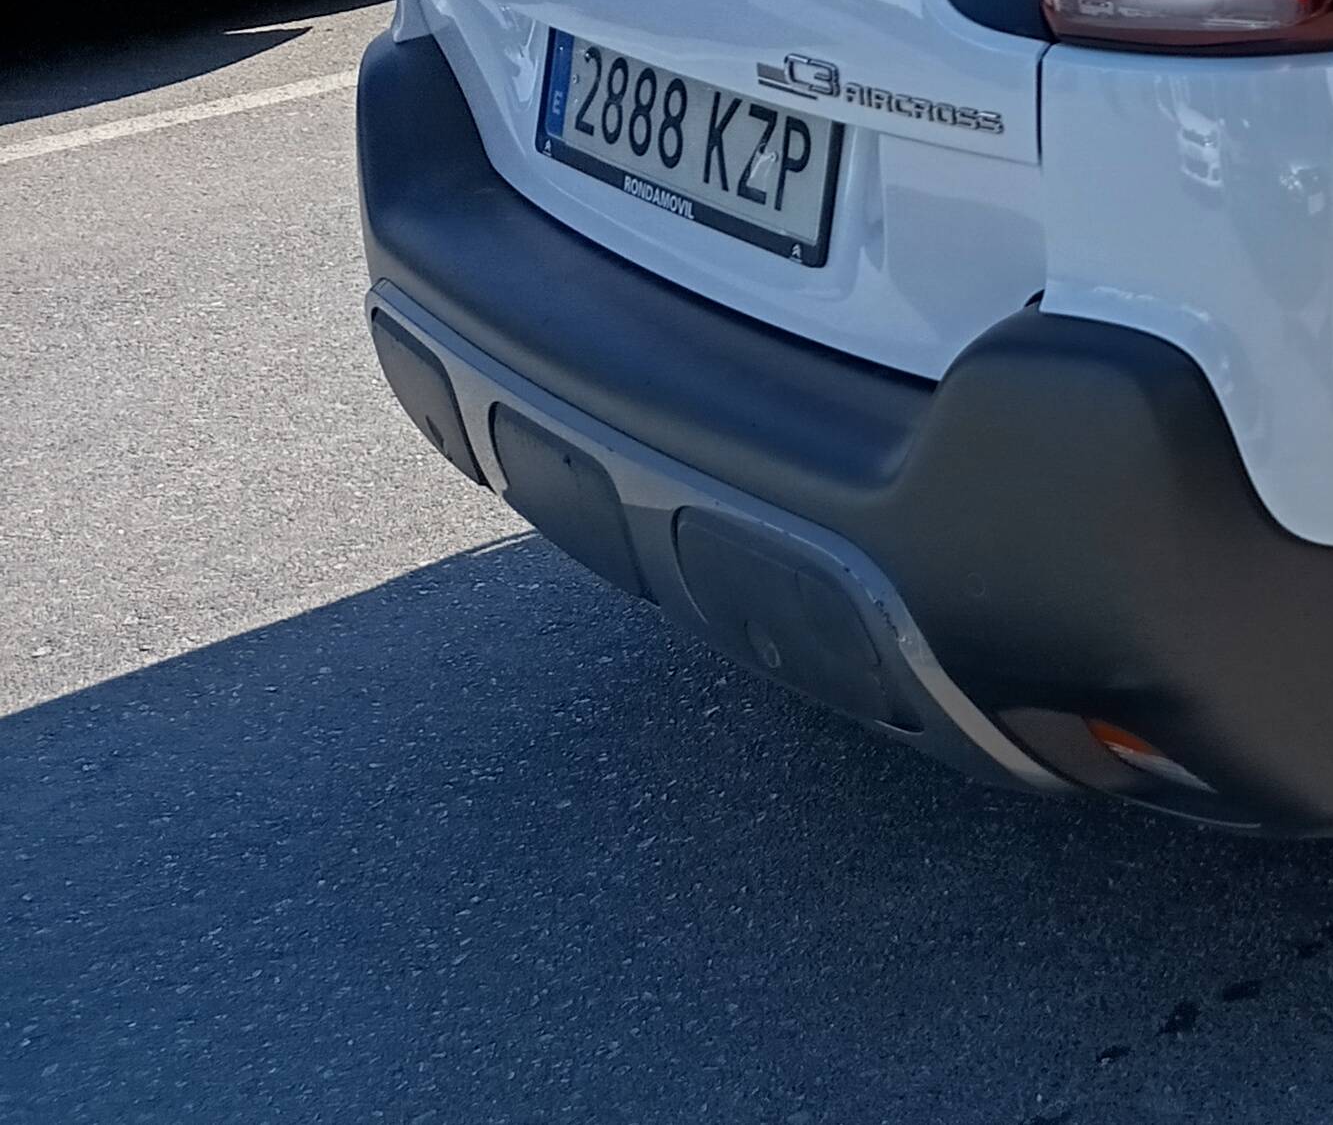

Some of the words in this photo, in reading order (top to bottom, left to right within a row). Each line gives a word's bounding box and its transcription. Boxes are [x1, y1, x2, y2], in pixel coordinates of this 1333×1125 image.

[575, 46, 687, 169] 2888
[703, 91, 812, 212] KZP
[784, 53, 841, 98] C3
[845, 82, 1005, 135] AIRCROSS
[623, 175, 695, 220] RONDAMOVIL
